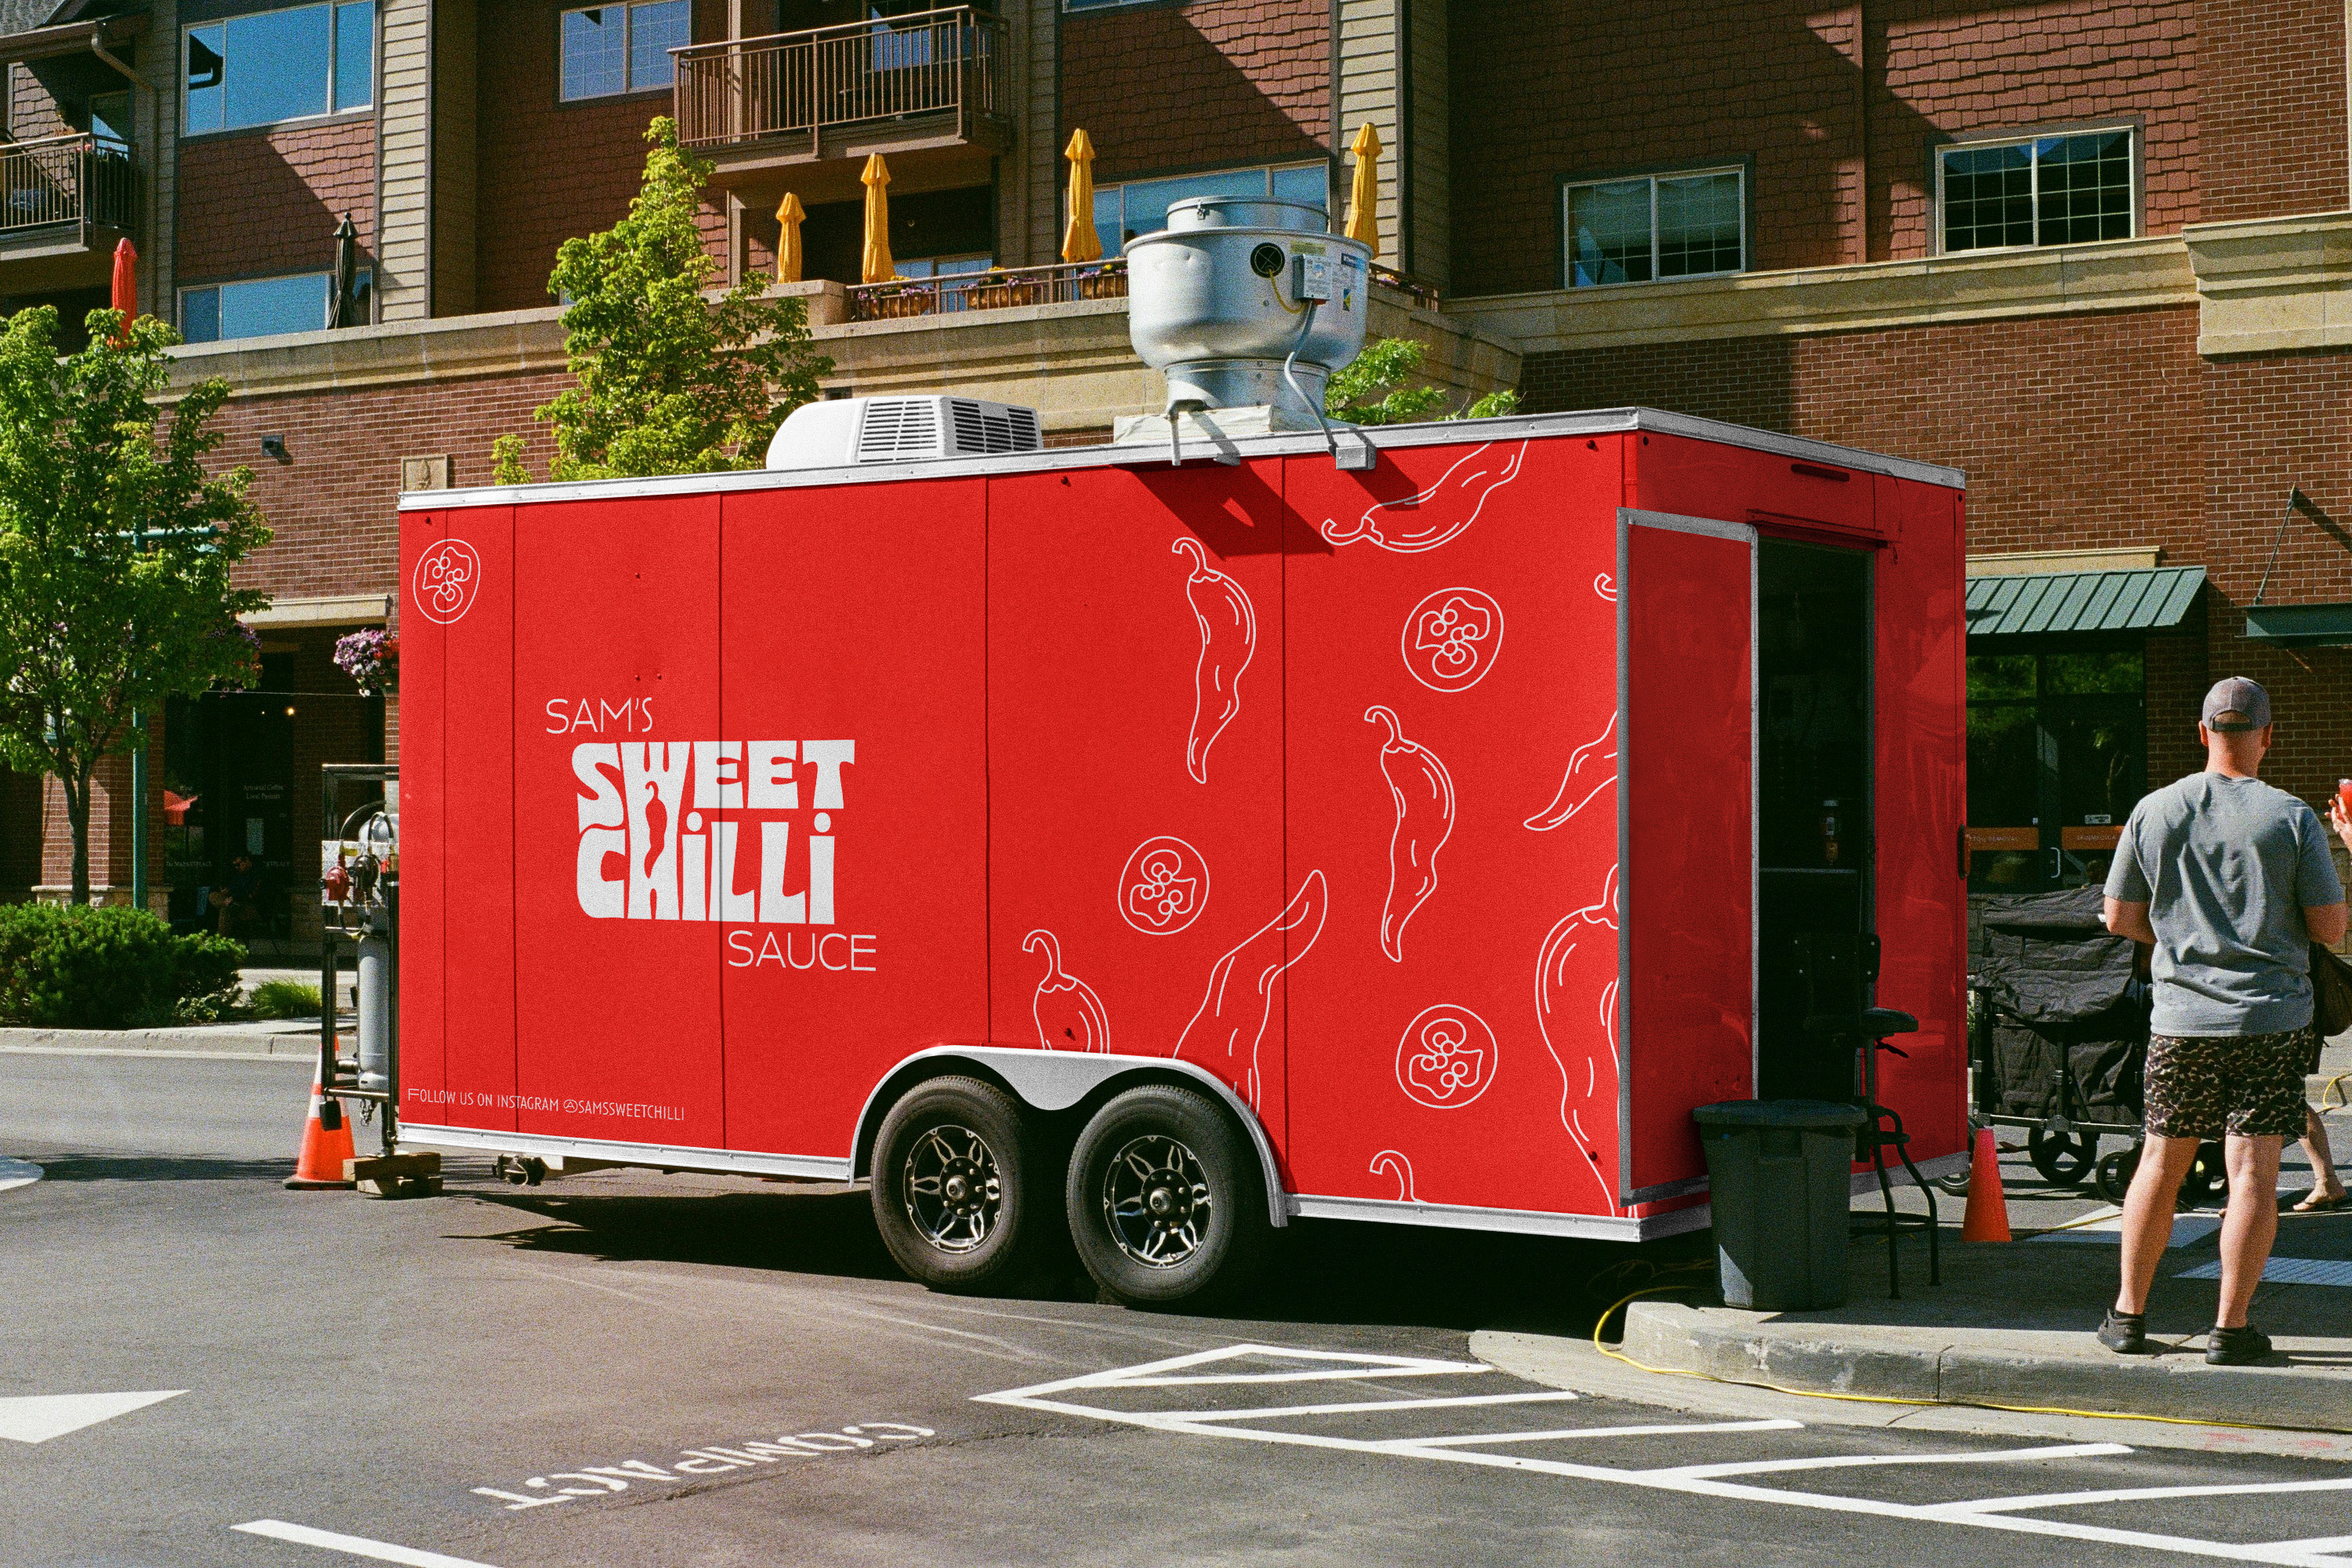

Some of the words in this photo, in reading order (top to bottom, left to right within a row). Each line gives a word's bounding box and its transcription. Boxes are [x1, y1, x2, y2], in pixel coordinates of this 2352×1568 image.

[546, 697, 652, 734] SAM'S
[572, 739, 855, 834] SWEET
[728, 930, 877, 971] SAUCE
[408, 1088, 456, 1105] FOLLOW
[459, 1092, 474, 1105] US
[477, 1093, 492, 1107] ON
[497, 1094, 559, 1112] INSTAGRAM
[563, 1098, 684, 1121] @SAMSSWEETCHILLI
[470, 1423, 935, 1510] COMPACT
